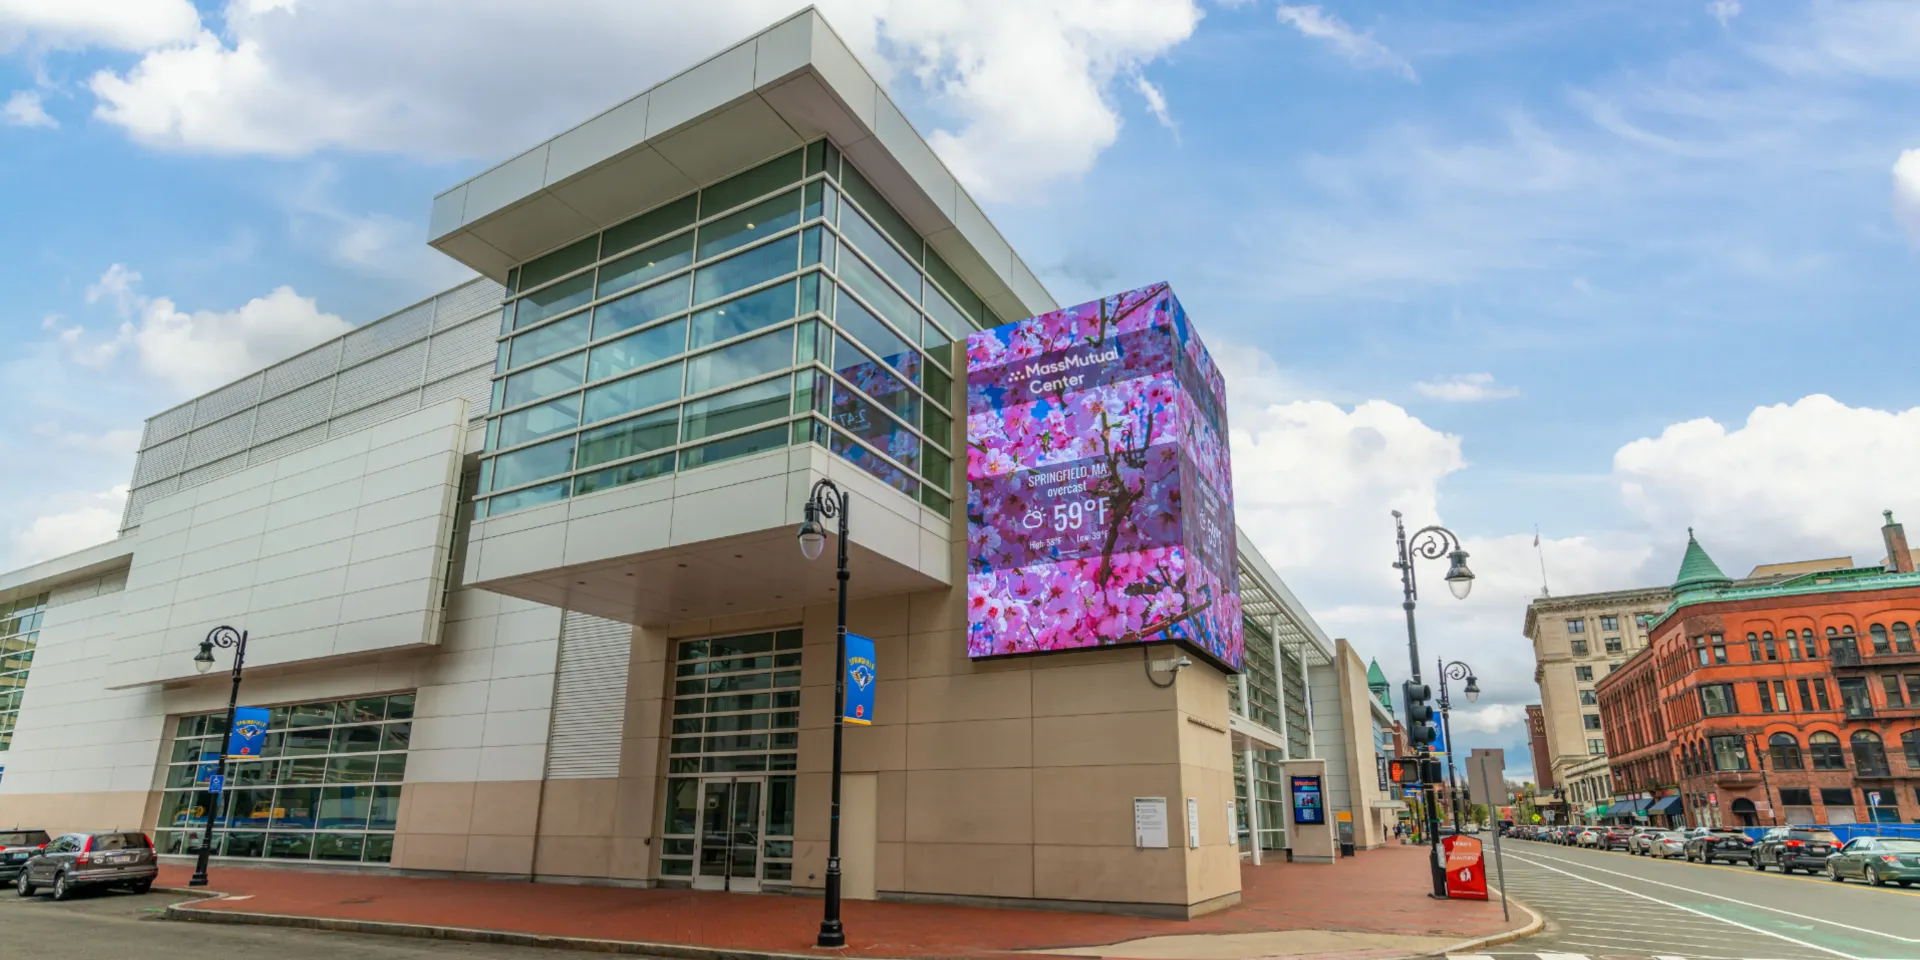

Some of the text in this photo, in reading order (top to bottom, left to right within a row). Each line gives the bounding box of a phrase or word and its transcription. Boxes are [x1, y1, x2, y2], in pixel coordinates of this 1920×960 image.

[1025, 346, 1119, 377] MassMutual
[1029, 374, 1085, 394] Center
[1028, 462, 1107, 488] SPRINGFIELD, MA
[1047, 480, 1087, 498] overcast
[1054, 496, 1110, 532] 59°F
